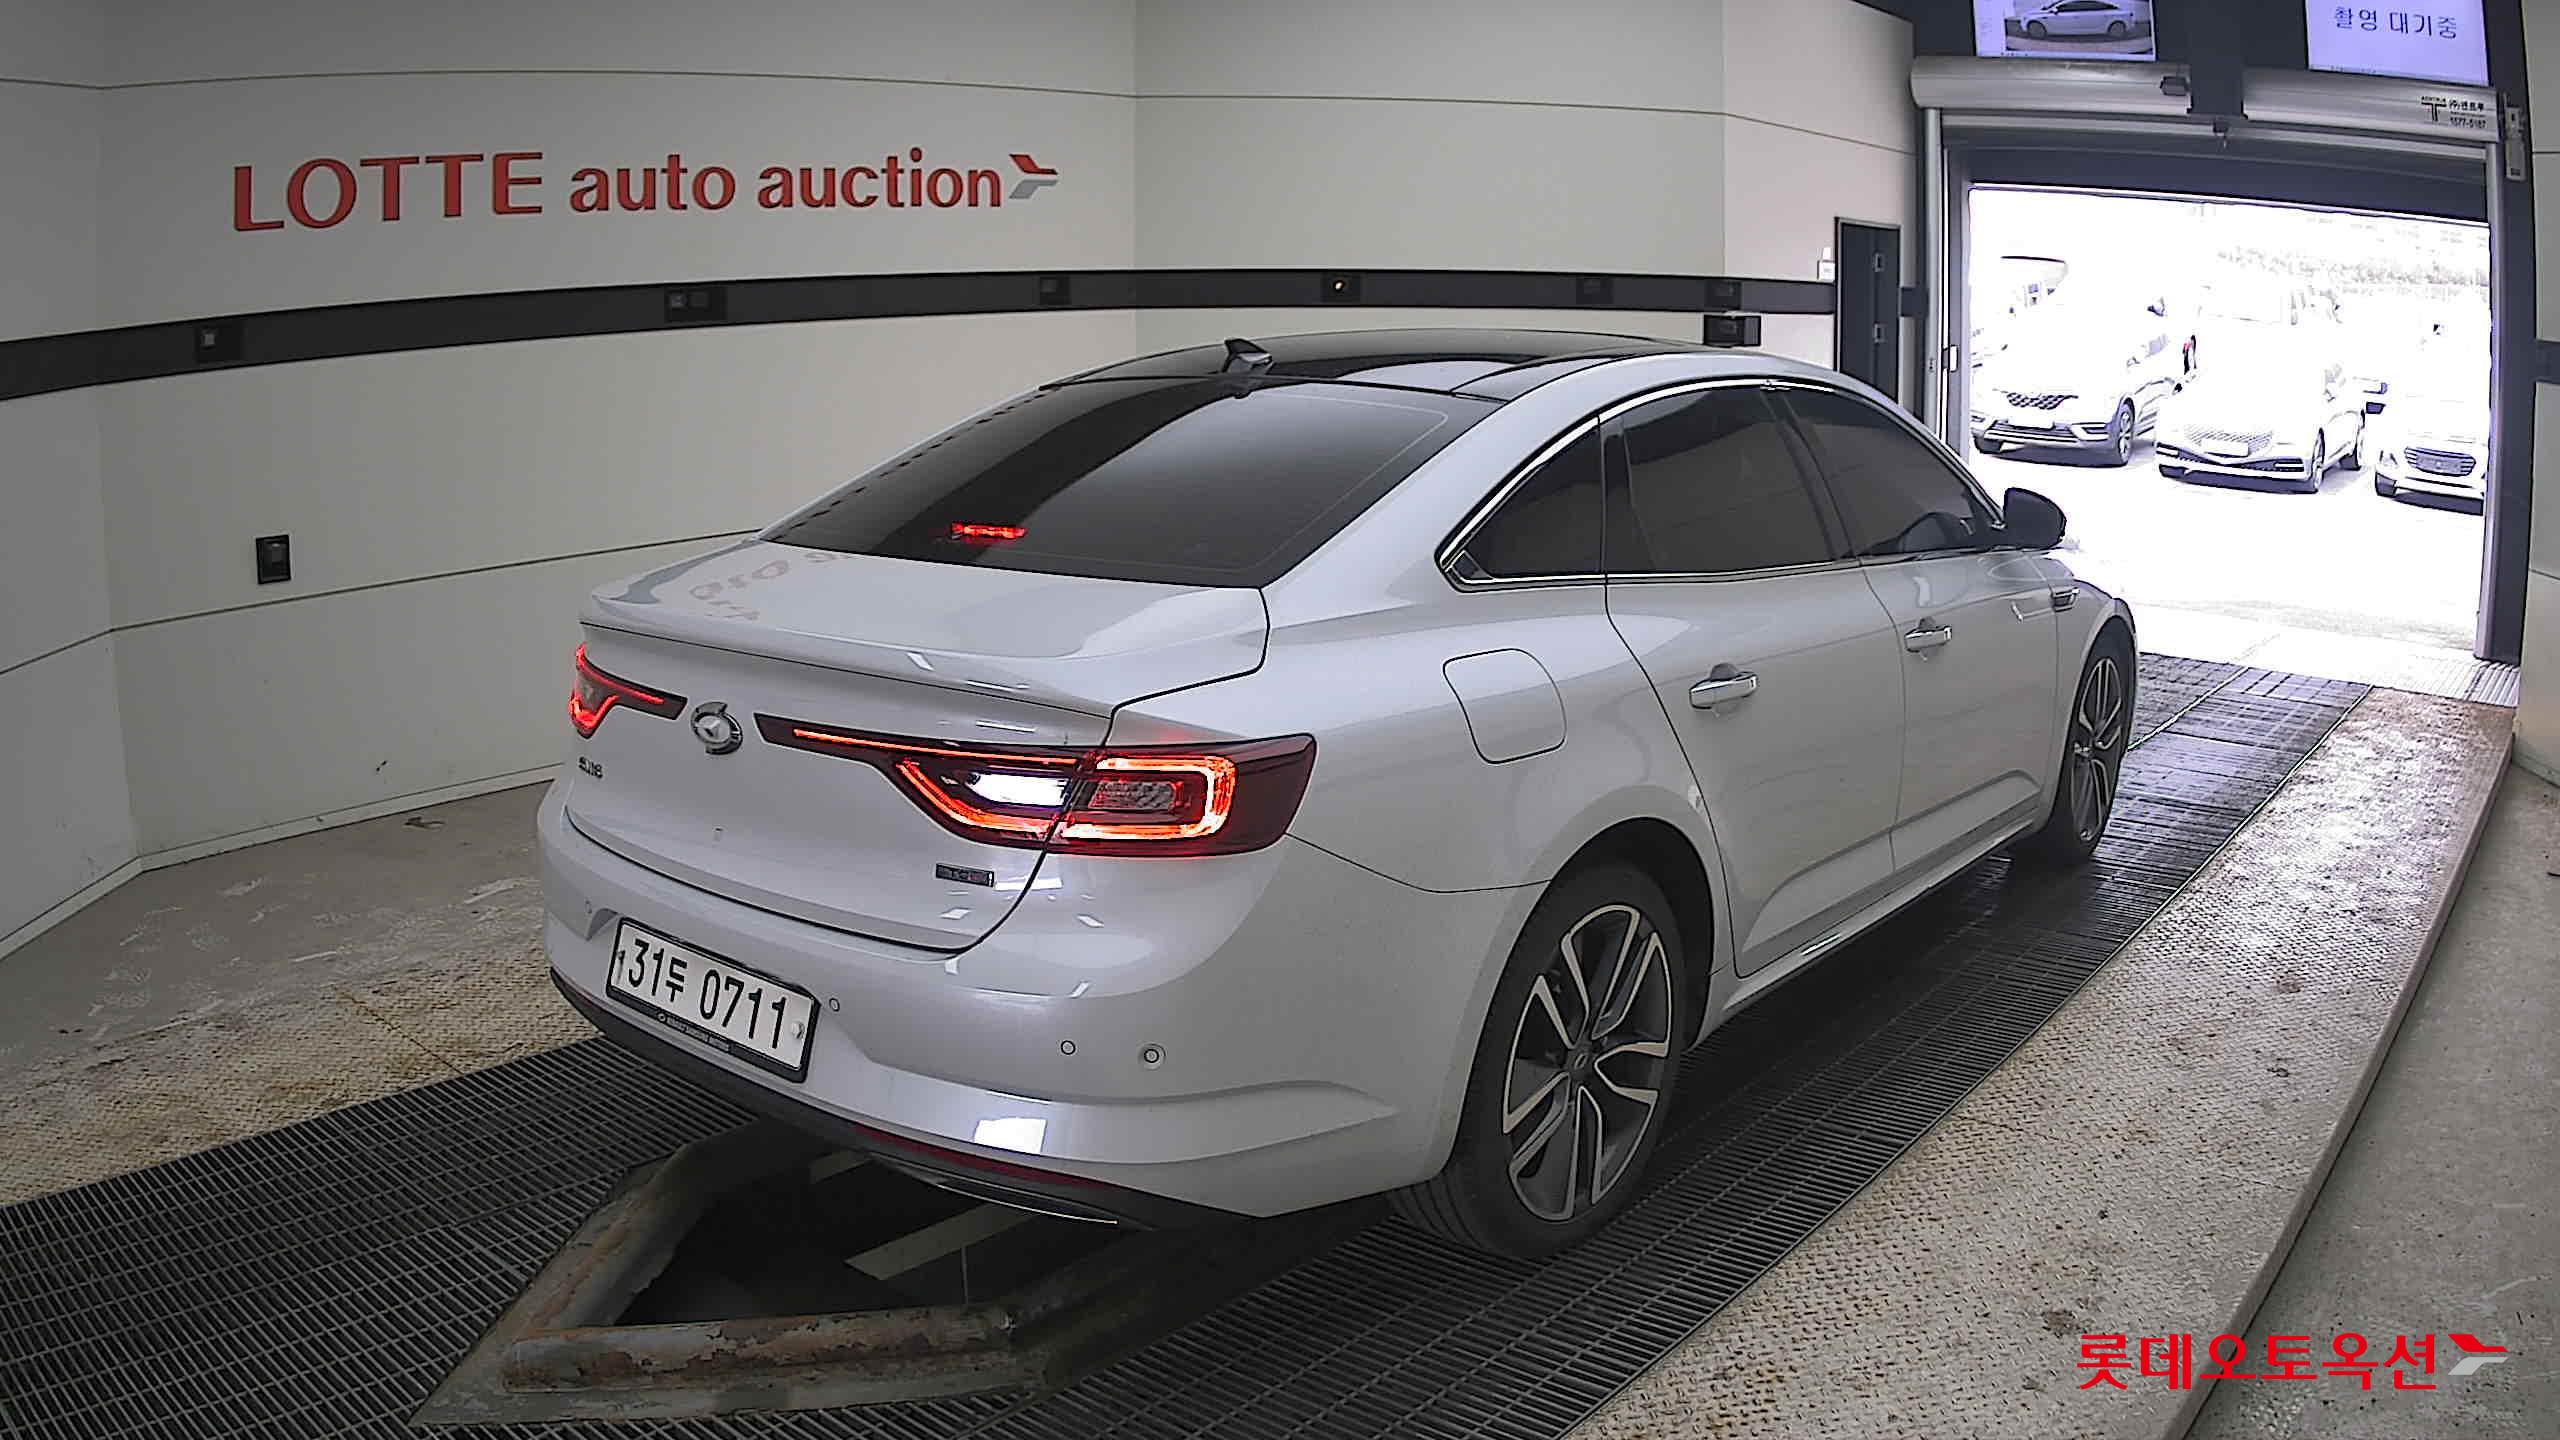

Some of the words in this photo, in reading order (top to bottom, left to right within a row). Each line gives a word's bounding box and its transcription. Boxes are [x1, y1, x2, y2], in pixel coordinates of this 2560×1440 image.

[2389, 12, 2457, 40] 대기중
[233, 151, 543, 232] LOTTE
[569, 153, 736, 213] auto
[757, 146, 1002, 209] auction
[627, 937, 688, 1003] 31두
[699, 968, 787, 1050] 0711
